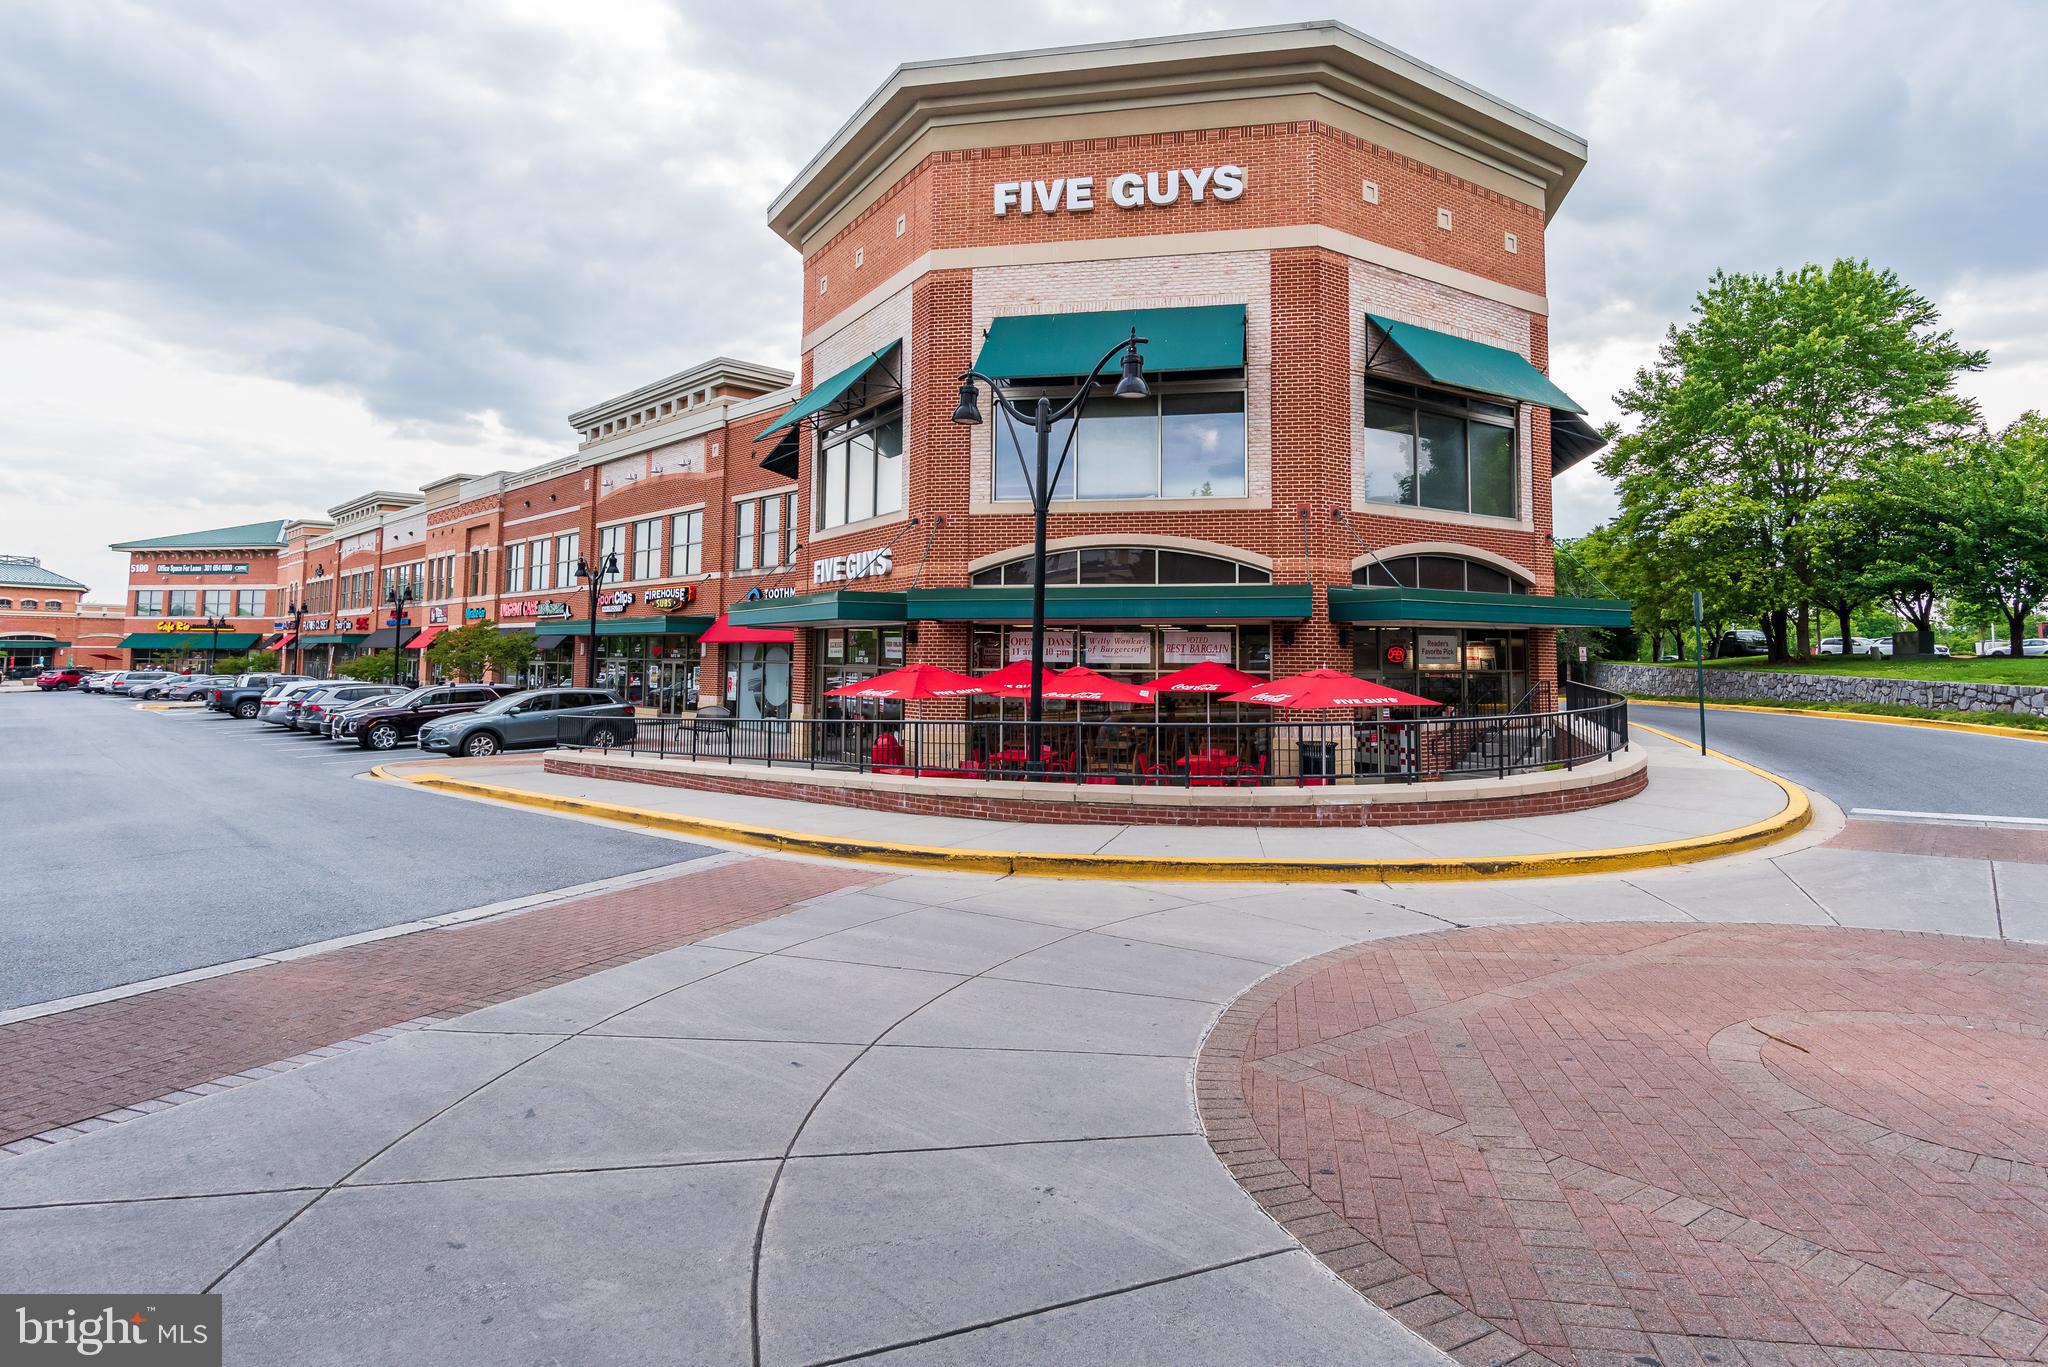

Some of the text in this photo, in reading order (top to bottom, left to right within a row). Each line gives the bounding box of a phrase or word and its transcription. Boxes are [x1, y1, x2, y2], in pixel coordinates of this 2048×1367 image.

[993, 164, 1245, 217] FIVE GUYS
[130, 564, 149, 573] 5100
[170, 565, 183, 573] Space
[814, 547, 893, 584] FIVE GUYS
[644, 587, 686, 604] FIREHOUSE
[523, 600, 538, 615] CARE
[655, 598, 672, 608] SUBS
[176, 621, 190, 632] Rio
[1010, 637, 1072, 647] OPE DAYS
[1114, 636, 1147, 645] Wonkas
[1012, 648, 1020, 656] 11
[1045, 648, 1054, 656] 10
[1056, 649, 1070, 658] pm
[1087, 646, 1097, 654] of
[1165, 643, 1230, 654] BEST BARGAIN
[1421, 648, 1455, 657] Favorite Pick
